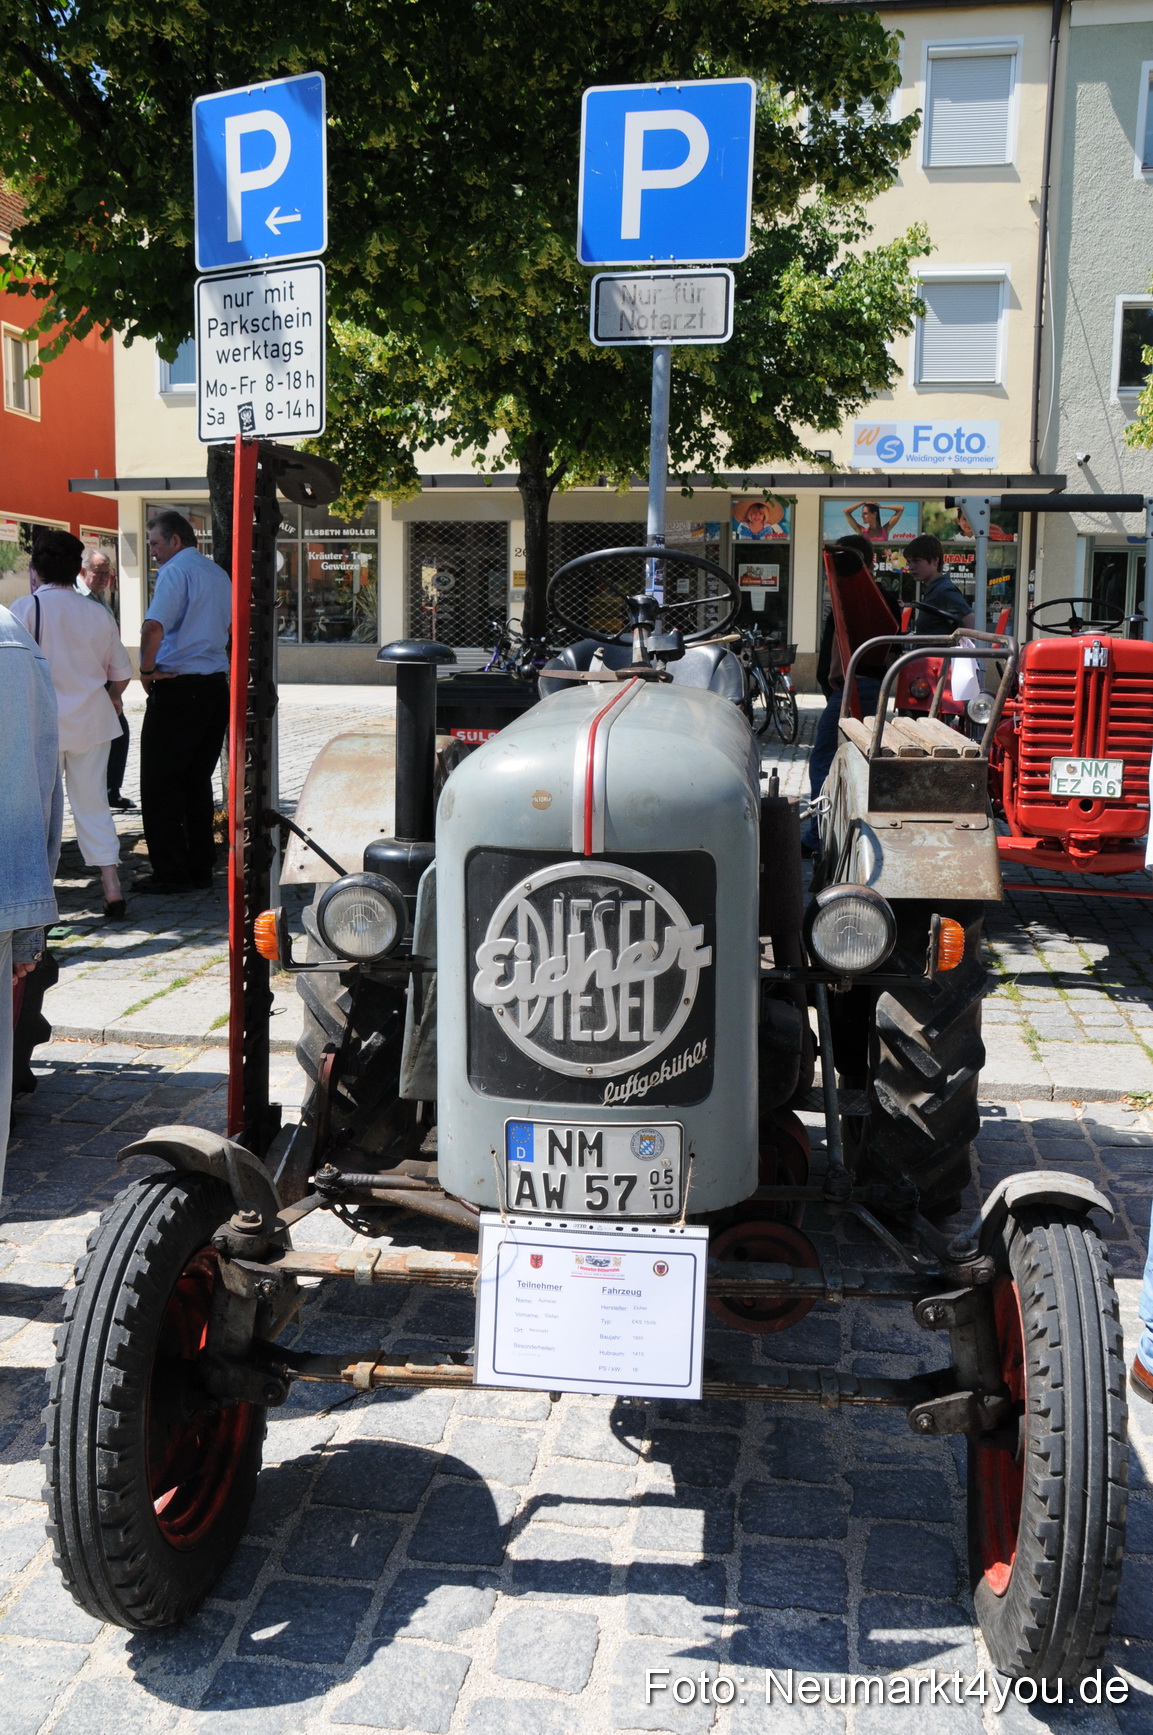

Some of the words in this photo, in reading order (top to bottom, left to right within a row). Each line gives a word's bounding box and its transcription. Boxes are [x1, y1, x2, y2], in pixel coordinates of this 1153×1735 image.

[225, 110, 292, 242] P
[620, 109, 710, 240] P
[223, 291, 254, 309] nur
[264, 280, 294, 304] mit
[622, 284, 662, 306] Nur
[673, 282, 706, 304] für
[208, 307, 312, 338] Parkschein
[618, 306, 706, 332] Notarzt
[216, 340, 304, 364] werktags
[206, 407, 225, 426] Sa
[912, 425, 986, 454] Foto
[906, 454, 946, 464] Weidinger
[954, 454, 995, 464] Stegmeier
[342, 528, 376, 536] MÜLLER
[308, 552, 343, 560] Kräuter
[320, 562, 360, 570] Gewürze
[1080, 761, 1108, 777] NM
[1056, 778, 1081, 794] EZ
[1092, 780, 1116, 796] 66
[472, 924, 712, 1005] Eicher
[603, 1038, 708, 1106] luftgekühlt
[516, 1146, 526, 1158] D
[548, 1128, 603, 1168] NM
[649, 1169, 673, 1185] 05
[514, 1170, 566, 1208] AW
[585, 1174, 637, 1211] 57
[652, 1194, 673, 1209] 10
[517, 1280, 563, 1291] Teilnehmer
[602, 1286, 642, 1297] Fahrzeug
